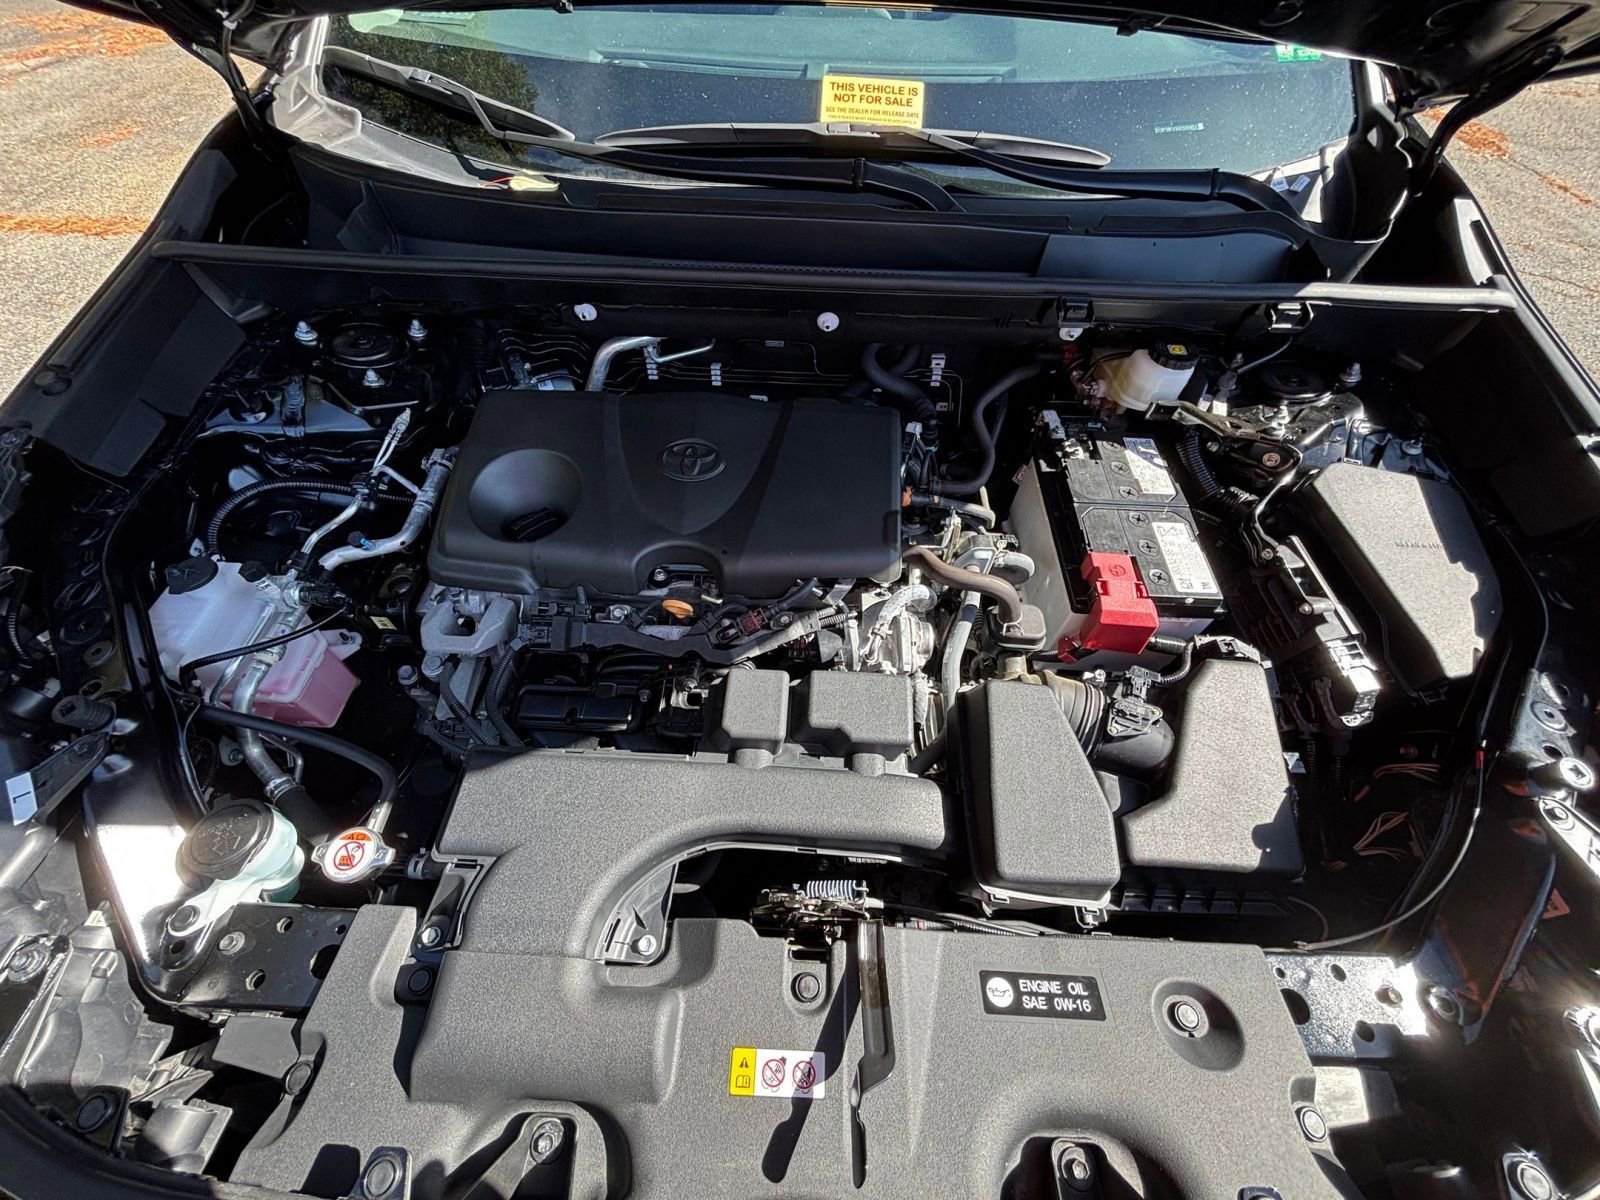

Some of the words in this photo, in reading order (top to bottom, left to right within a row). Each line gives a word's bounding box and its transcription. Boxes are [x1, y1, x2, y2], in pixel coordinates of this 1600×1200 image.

[830, 82, 854, 91] THIS
[858, 83, 904, 95] VEHICLE
[908, 87, 918, 96] IS
[833, 93, 857, 102] NOT
[859, 95, 882, 104] FOR
[885, 97, 913, 107] SALE
[1018, 979, 1062, 994] ENGINE
[1067, 982, 1089, 995] OIL
[1022, 995, 1048, 1009] SAE
[1053, 997, 1092, 1012] 0W-16
